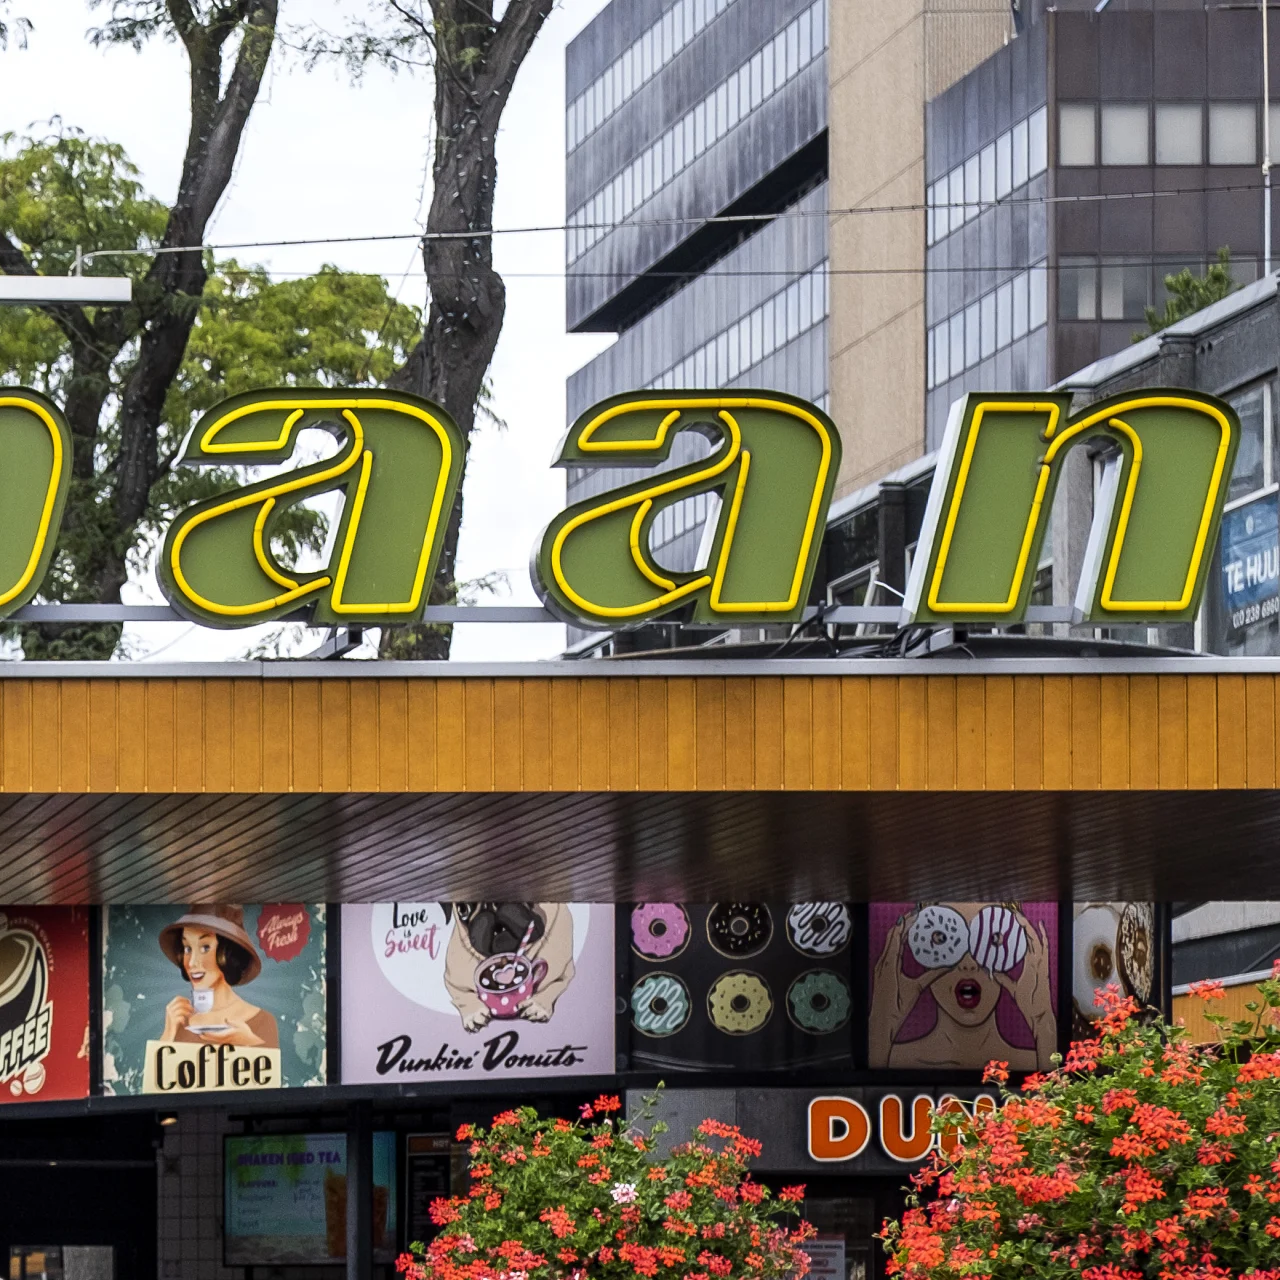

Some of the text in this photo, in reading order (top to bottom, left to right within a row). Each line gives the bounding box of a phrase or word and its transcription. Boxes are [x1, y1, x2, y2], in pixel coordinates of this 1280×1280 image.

[1224, 545, 1280, 595] TE HUU
[260, 911, 304, 939] Always
[392, 903, 429, 929] Love
[267, 930, 298, 952] Fresh
[384, 924, 441, 961] Sweet
[155, 1043, 273, 1092] Coffee
[375, 1030, 589, 1076] Dunkin' Donuts
[807, 1094, 1022, 1163] DUN
[317, 1151, 341, 1164] TEA
